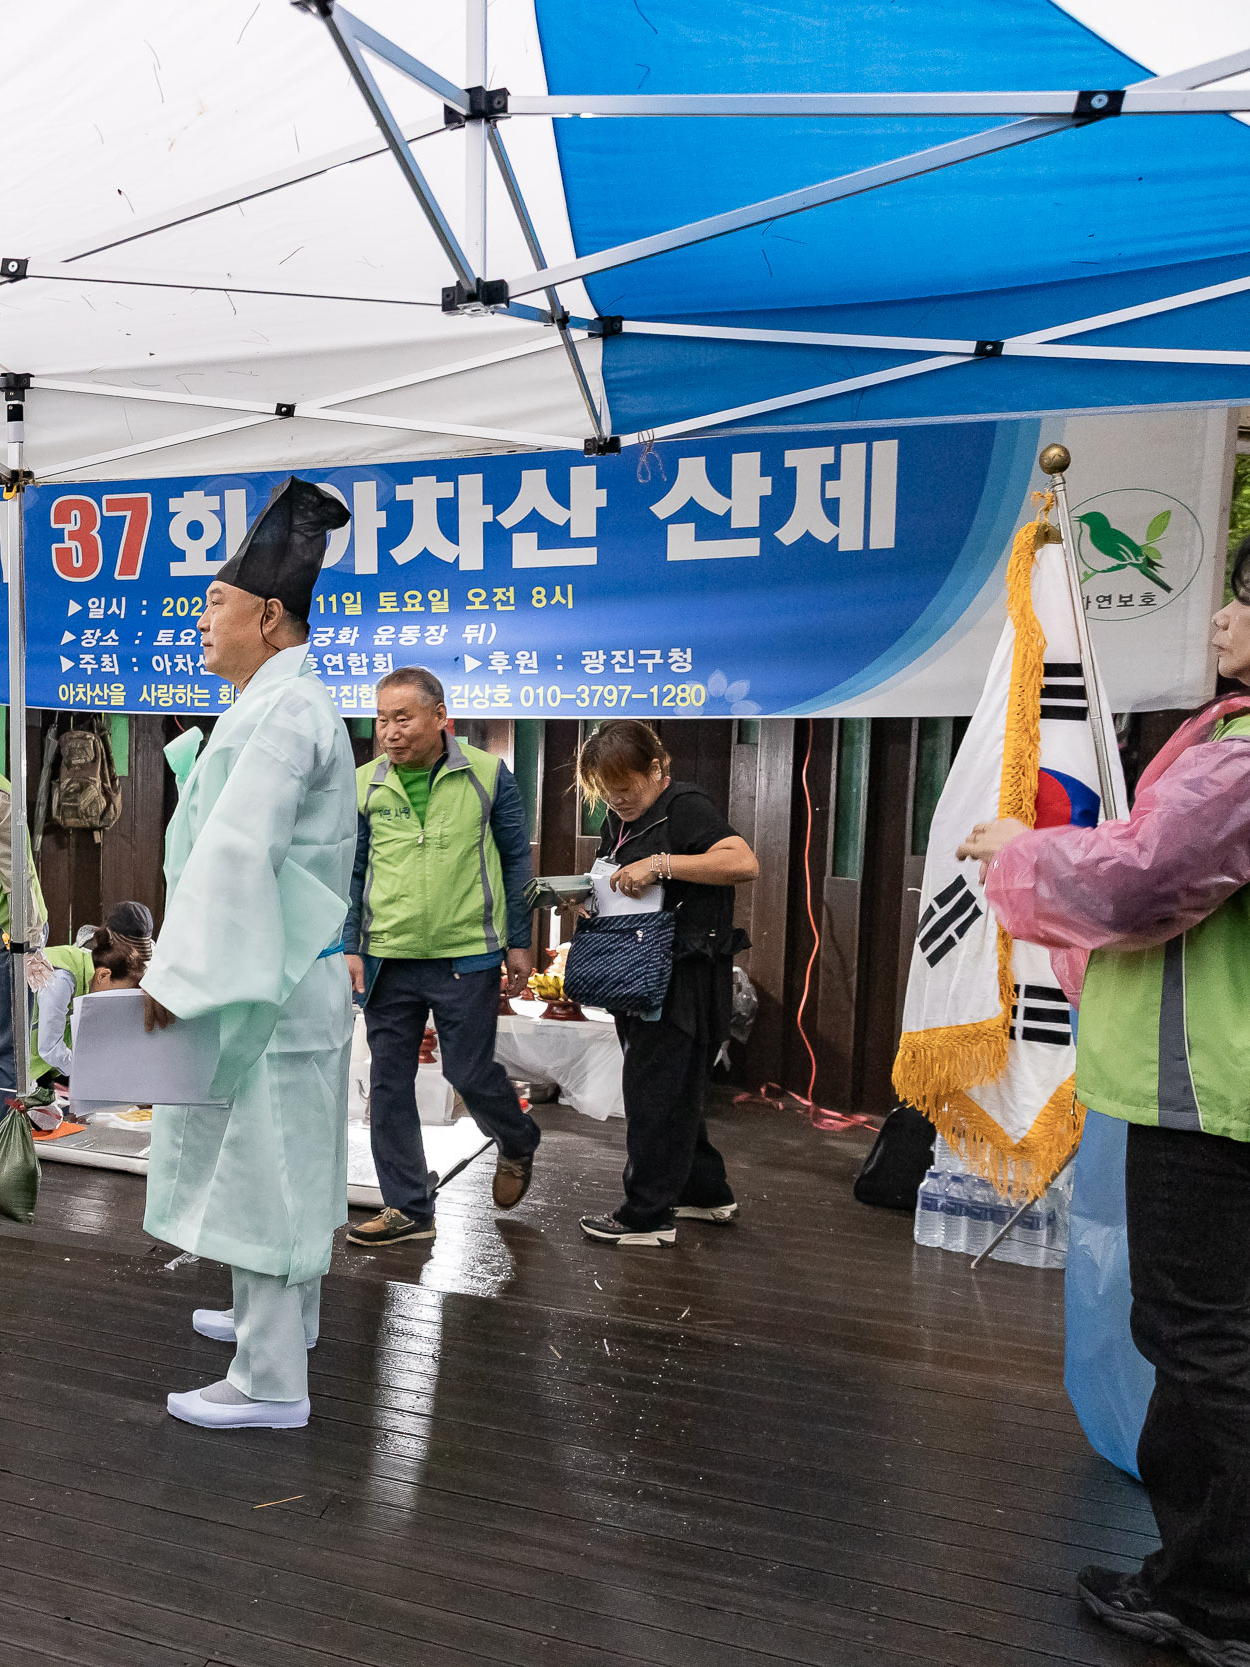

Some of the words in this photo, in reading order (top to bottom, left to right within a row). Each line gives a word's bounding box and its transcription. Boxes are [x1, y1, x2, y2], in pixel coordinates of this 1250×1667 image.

[649, 439, 898, 562] 산제
[87, 597, 126, 618] 일시
[316, 592, 362, 615] 11일
[377, 588, 450, 613] 토요일
[465, 586, 516, 611] 오전
[531, 583, 574, 609] 8시
[80, 629, 120, 647] 장소
[152, 628, 206, 647] 토요
[307, 626, 360, 647] 궁화
[372, 624, 448, 646] 운동장
[461, 622, 497, 646] 뒤)
[79, 654, 120, 675] 주최
[488, 650, 539, 674] 후원
[580, 648, 693, 674] 광진구청
[58, 682, 126, 706] 아차산을
[138, 683, 211, 707] 사랑하는
[217, 684, 240, 707] 회
[451, 684, 512, 709] 김상호
[519, 684, 706, 708] 010-3797-1280
